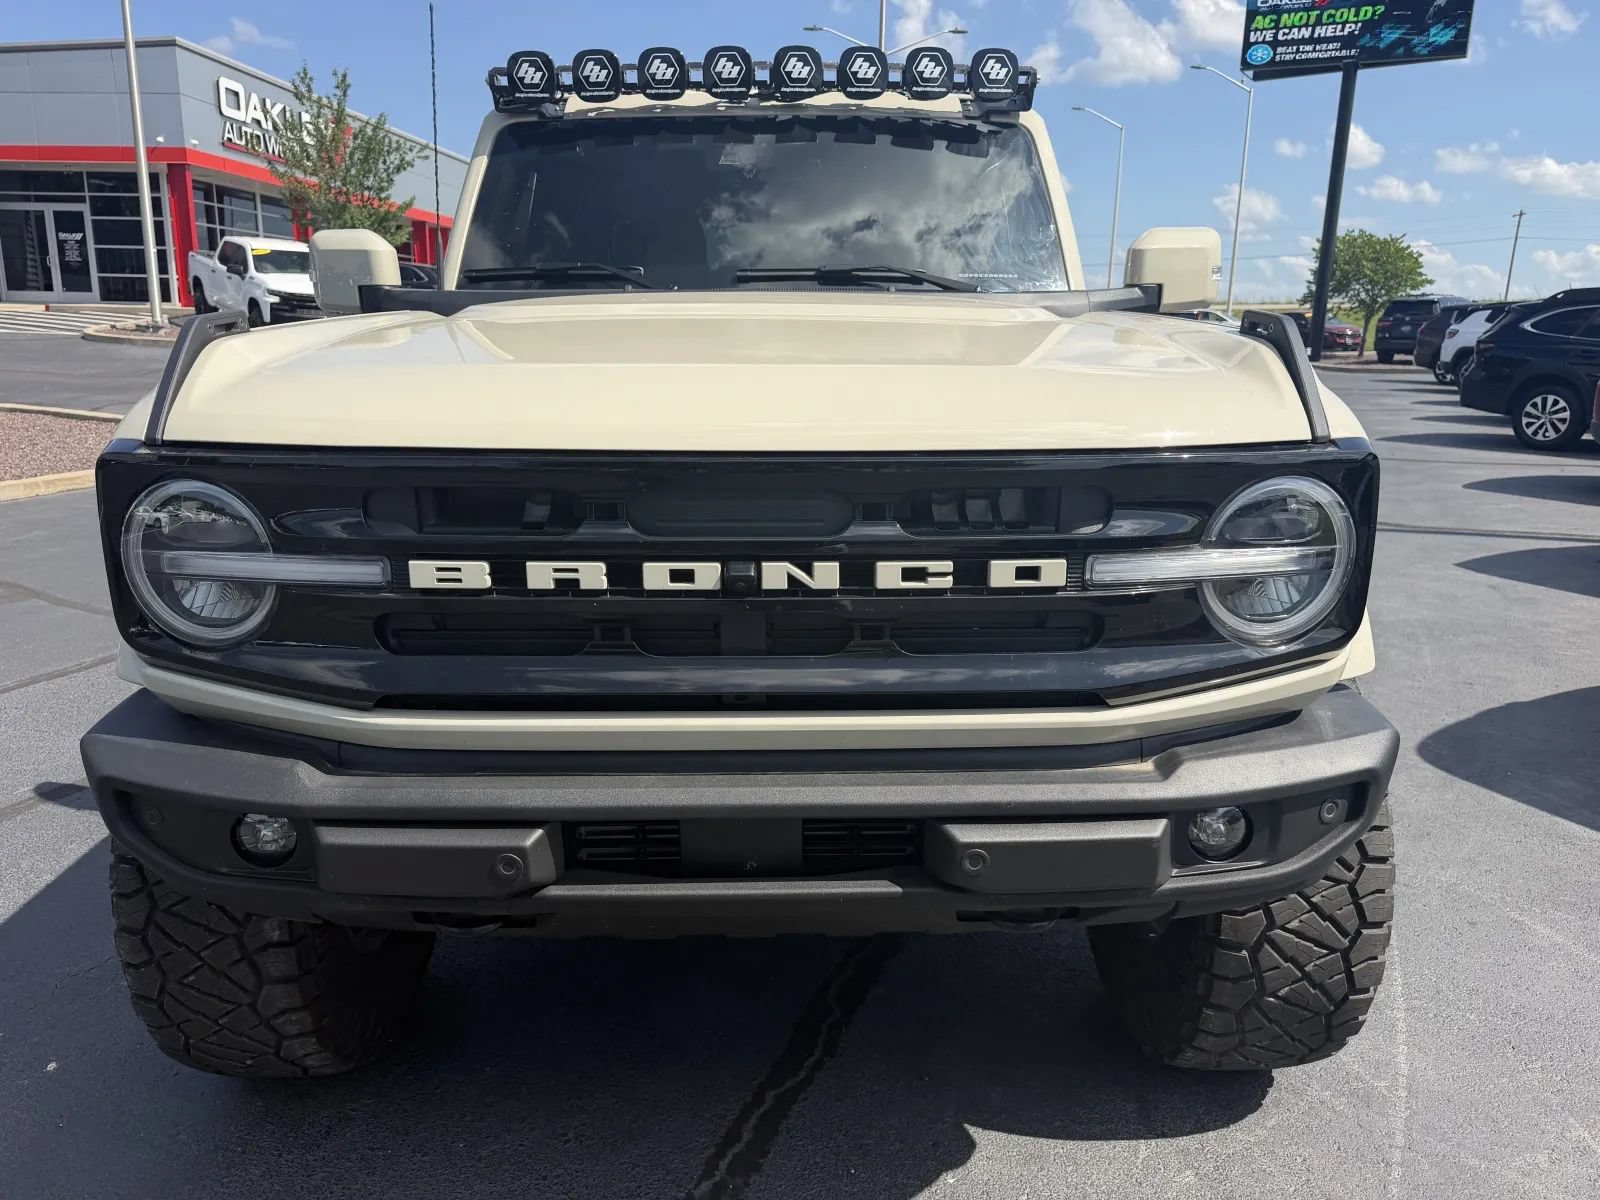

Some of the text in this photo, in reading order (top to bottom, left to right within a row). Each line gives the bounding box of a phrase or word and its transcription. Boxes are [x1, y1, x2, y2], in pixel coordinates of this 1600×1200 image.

[1250, 14, 1277, 30] AC
[1279, 10, 1320, 27] NOT
[1322, 5, 1385, 24] COLD?
[1249, 22, 1362, 42] WE CAN HELP!
[1274, 53, 1295, 62] STAY
[1276, 45, 1297, 53] BEAT
[1299, 44, 1314, 52] THE
[408, 558, 1067, 590] BRONCO
